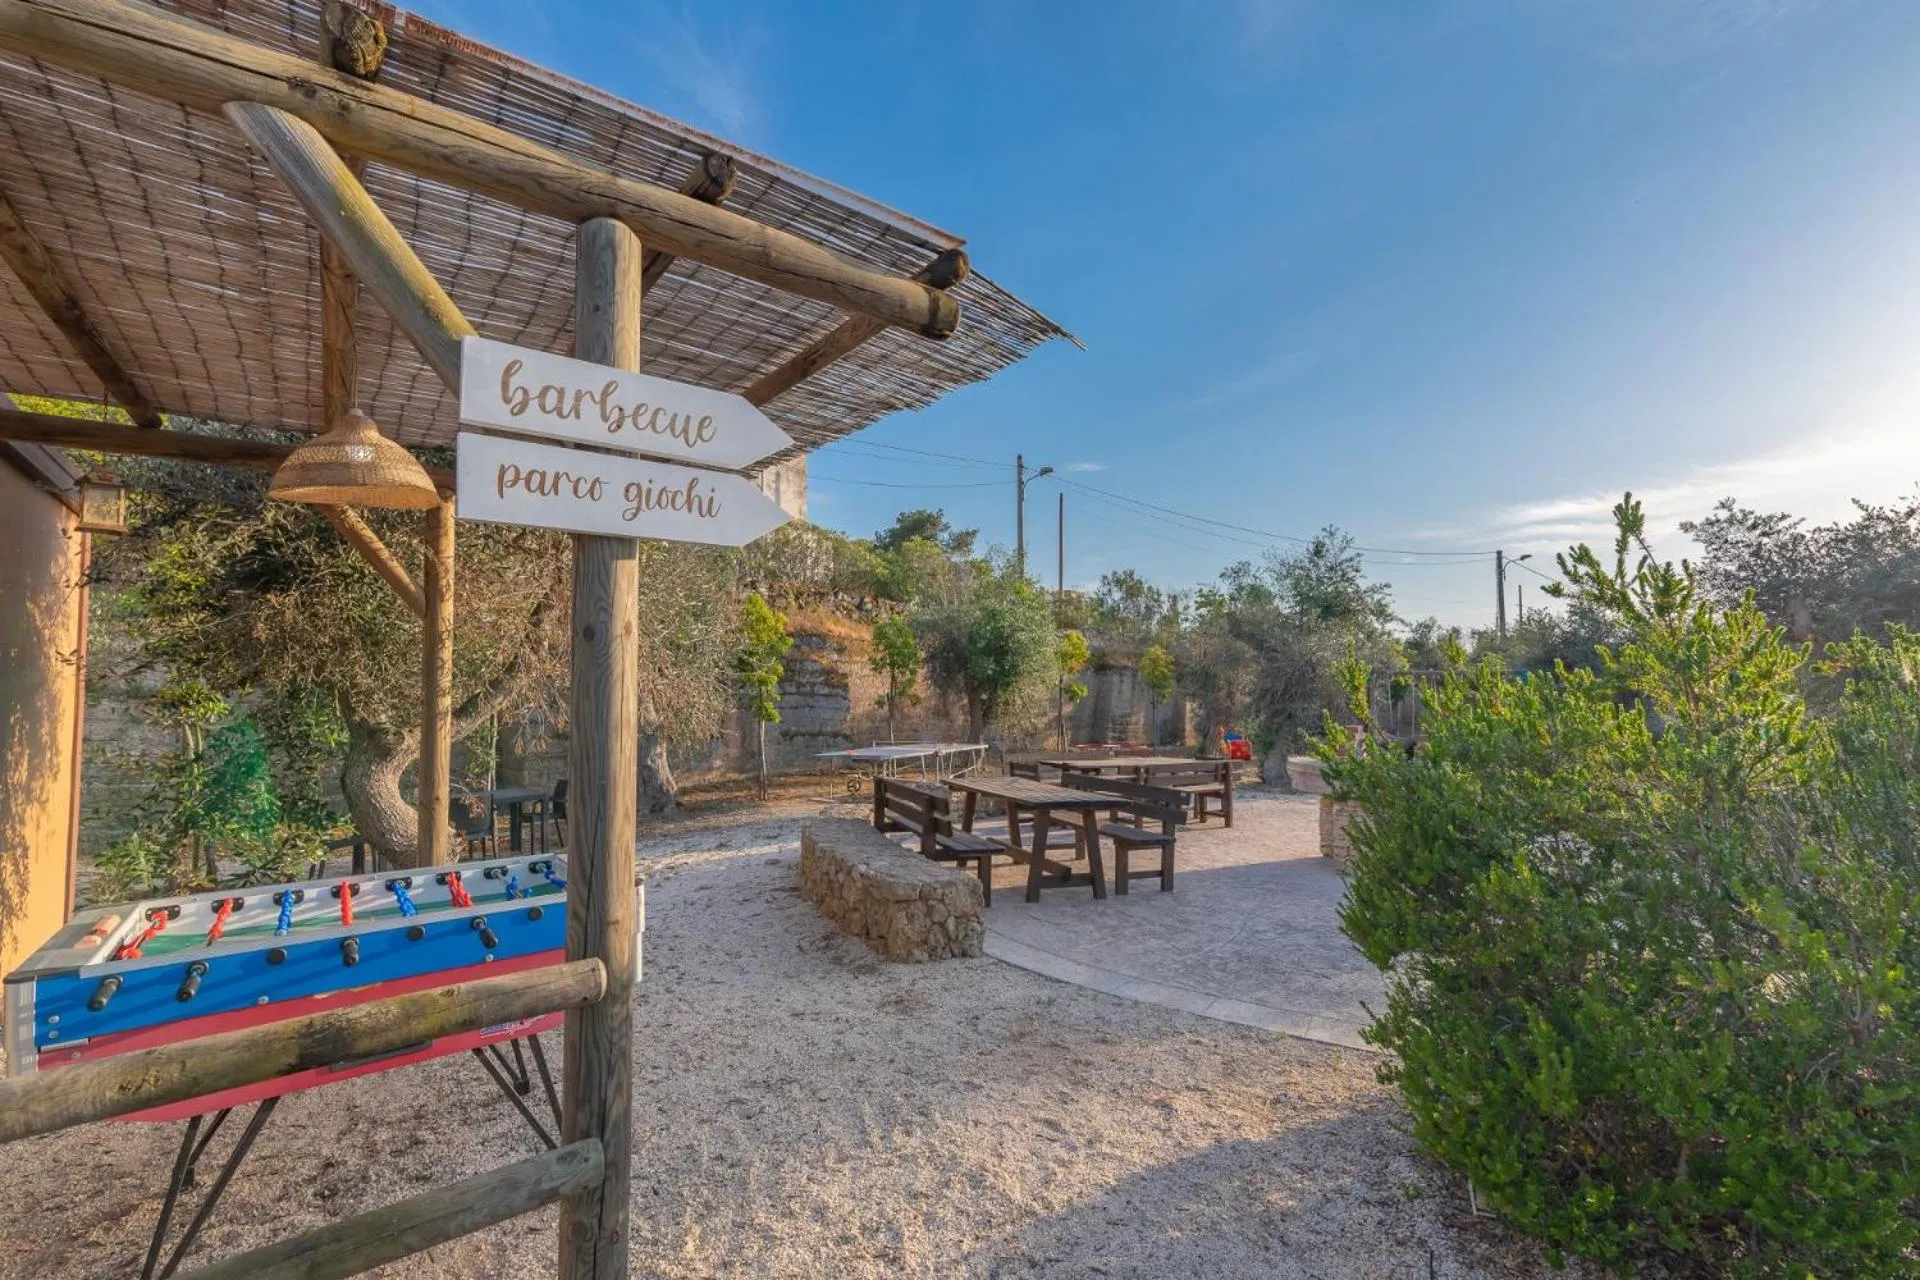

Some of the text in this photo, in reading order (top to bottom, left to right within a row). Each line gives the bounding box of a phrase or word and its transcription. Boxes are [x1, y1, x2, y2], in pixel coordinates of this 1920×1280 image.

[500, 359, 717, 448] barbecue
[496, 463, 722, 522] parco giochi
